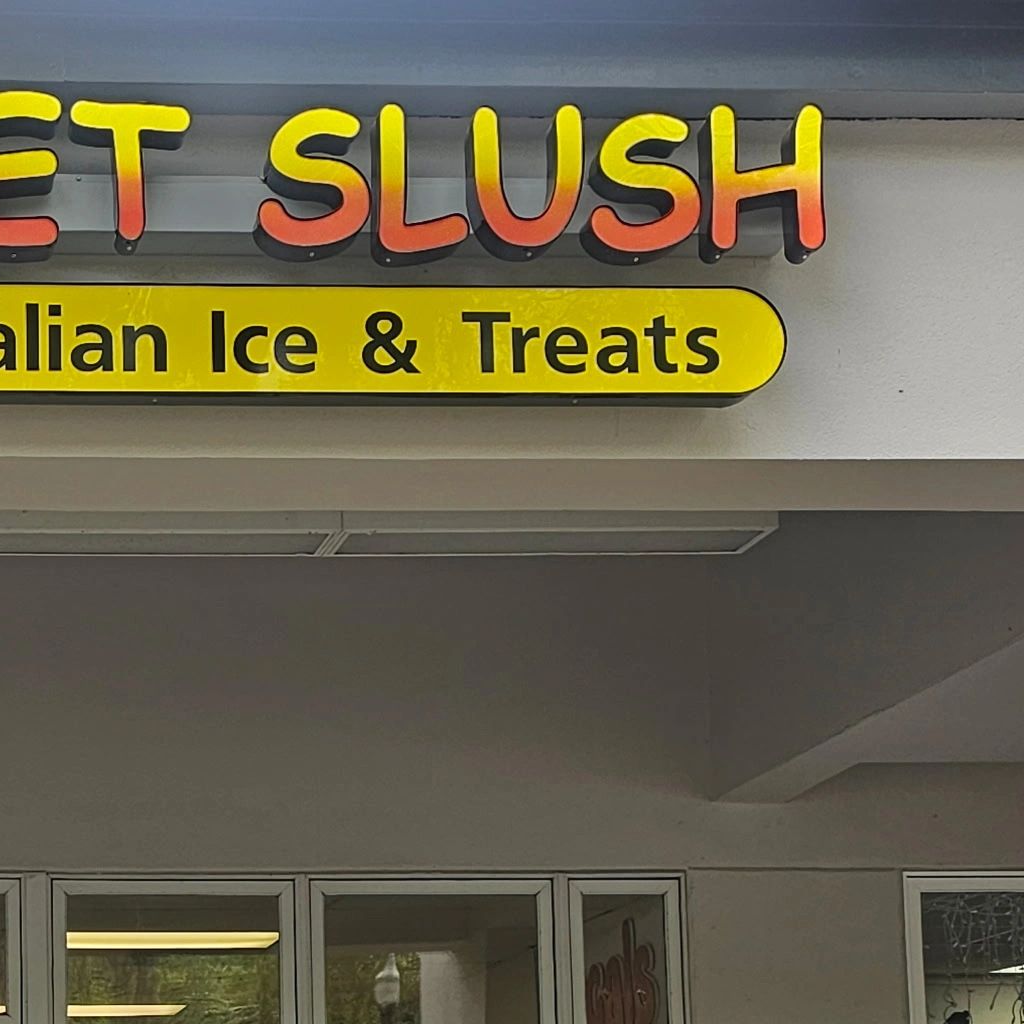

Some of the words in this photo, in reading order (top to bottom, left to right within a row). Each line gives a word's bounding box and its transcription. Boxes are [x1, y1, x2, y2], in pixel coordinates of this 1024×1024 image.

[259, 103, 826, 254] SLUSH
[210, 310, 318, 374] Ice
[360, 310, 420, 375] &
[461, 311, 719, 376] Treats
